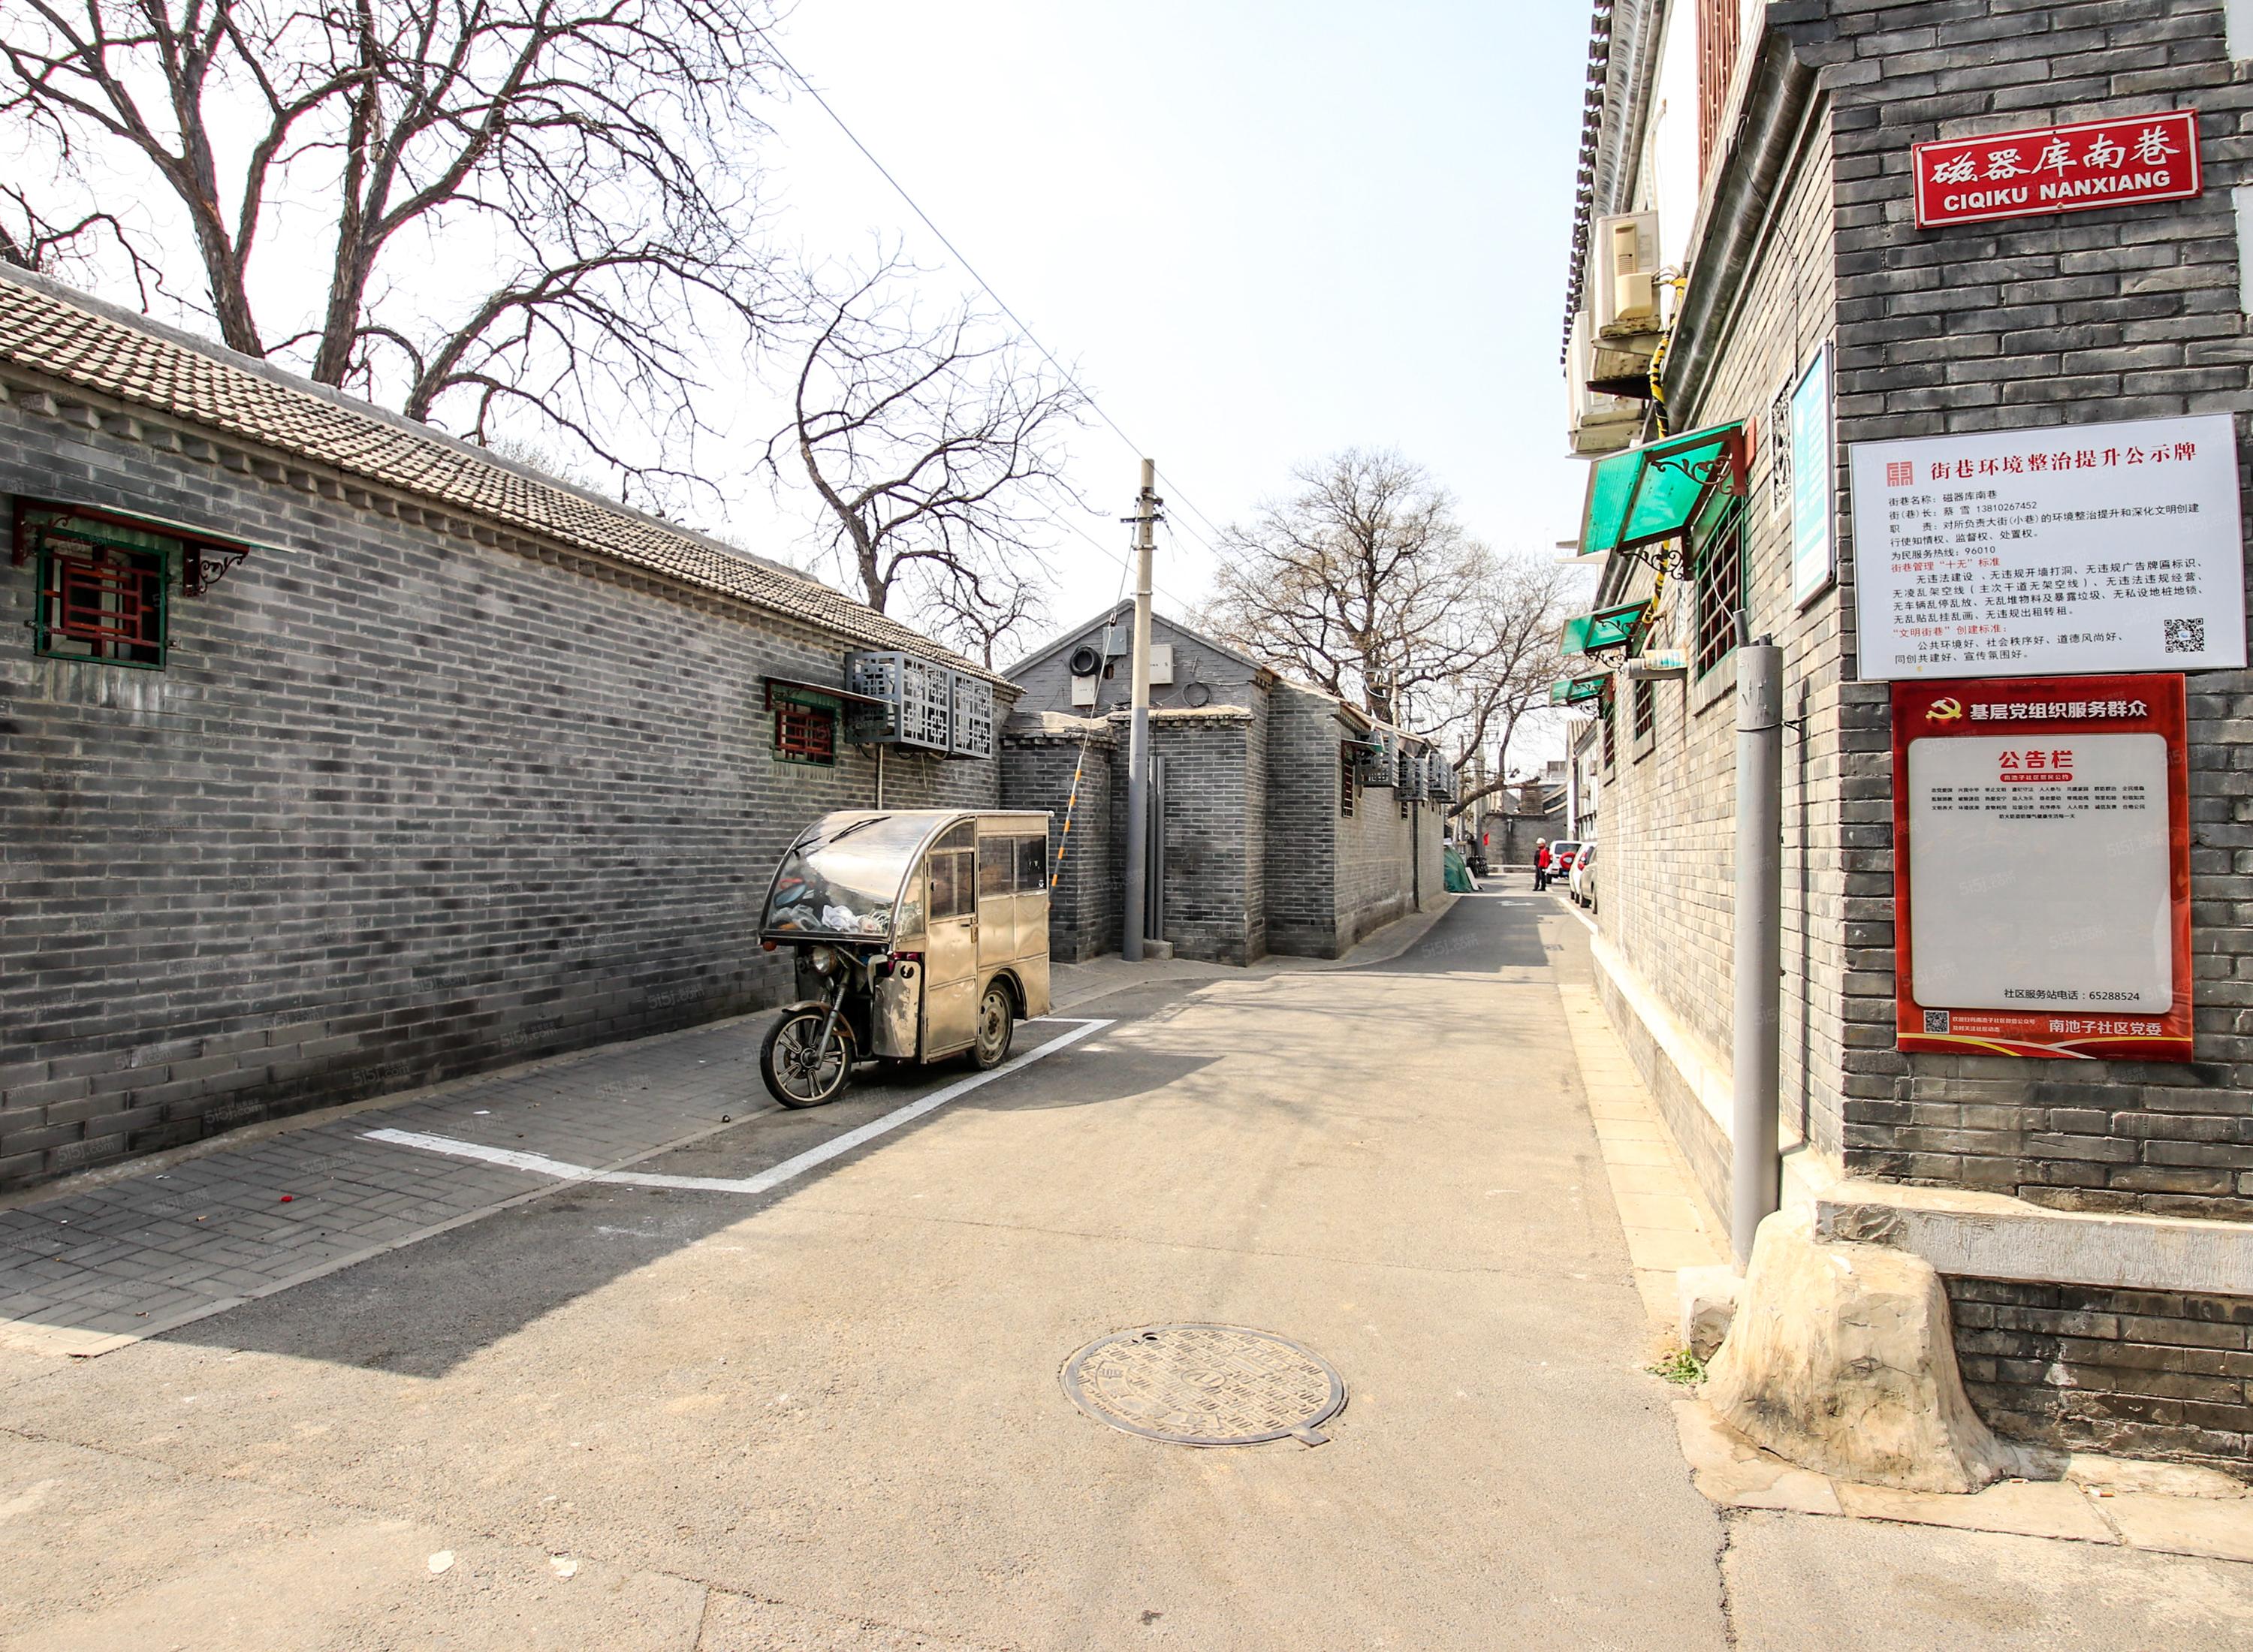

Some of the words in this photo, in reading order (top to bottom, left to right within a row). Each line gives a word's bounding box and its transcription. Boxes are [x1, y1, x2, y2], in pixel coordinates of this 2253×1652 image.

[1929, 125, 2180, 185] 磁器库南巷
[1944, 186, 2028, 212] CIQIKU
[2040, 170, 2170, 200] NANXIANG
[1930, 442, 2197, 481] 街巷环境整治提升公示牌
[1890, 529, 2038, 547] 行使知情权、监督权、处置权。
[1969, 700, 2148, 721] 基层党组织服务群众
[1998, 749, 2074, 770] 公告栏
[2049, 1019, 2162, 1036] 南池子社区党委
